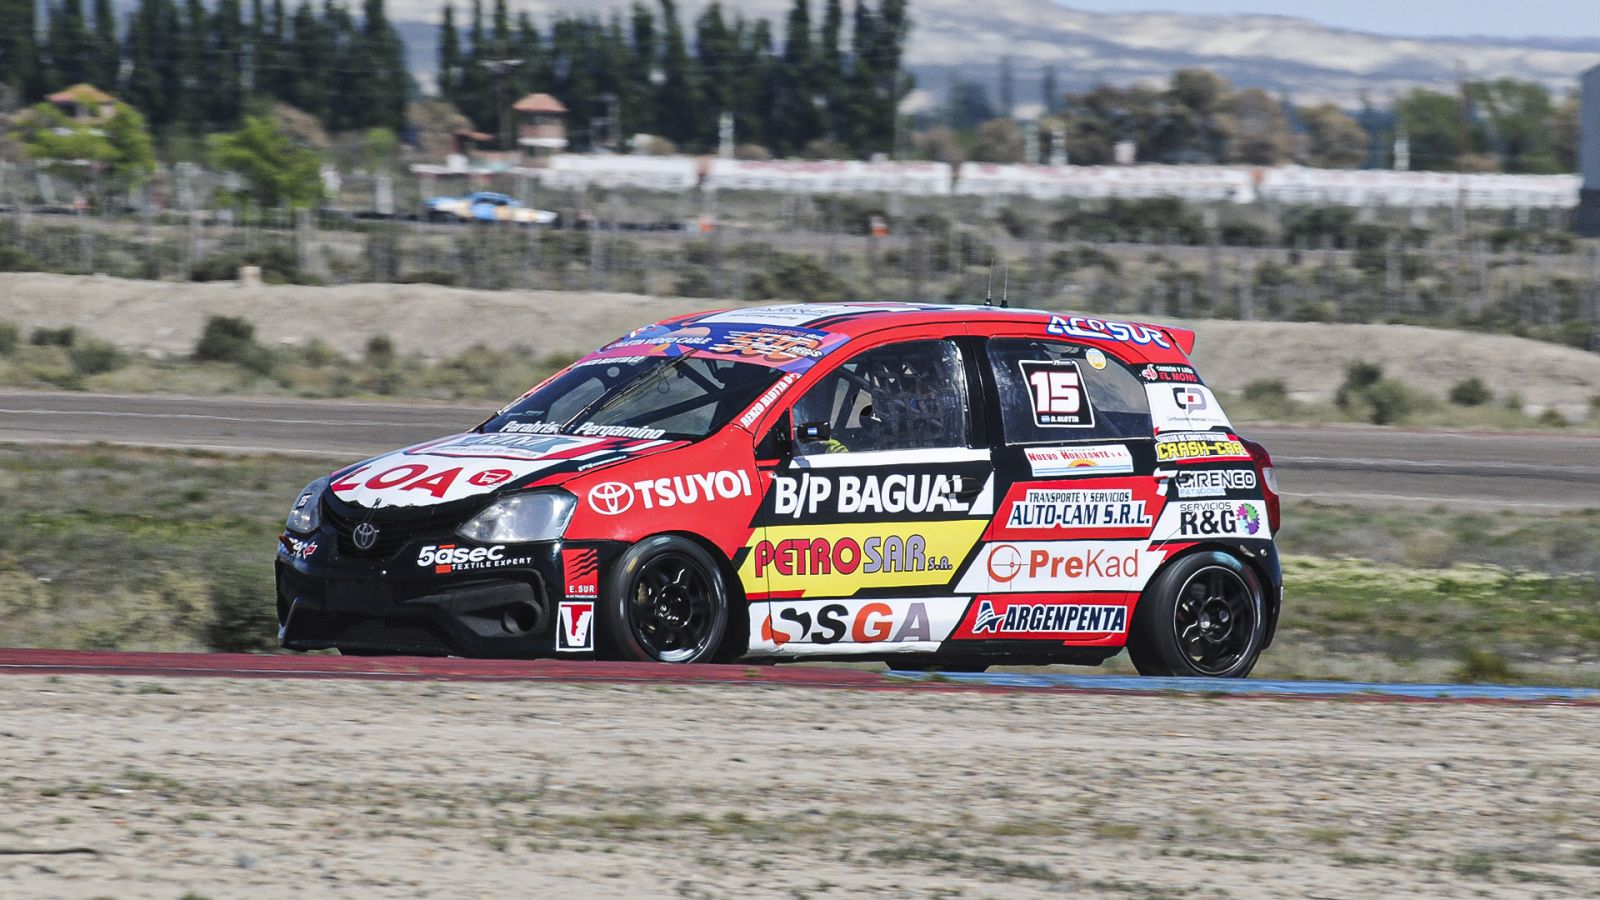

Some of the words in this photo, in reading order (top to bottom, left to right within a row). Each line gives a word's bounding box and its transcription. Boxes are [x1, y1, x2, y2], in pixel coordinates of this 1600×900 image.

[1159, 372, 1171, 381] EL
[1171, 373, 1198, 382] MONO
[740, 402, 765, 428] RENZO
[760, 381, 788, 407] BLOTTA
[1030, 371, 1080, 413] 15
[573, 422, 665, 439] Pergamino
[1028, 453, 1059, 462] NUEVO
[1060, 451, 1110, 460] HORIZONTE
[634, 469, 752, 509] TSUYOI
[775, 473, 831, 518] B/P
[837, 474, 969, 514] BAGUAL
[1029, 492, 1080, 503] TRANSPORTE
[1082, 492, 1088, 502] Y
[1090, 491, 1130, 502] SERVICIOS
[1010, 504, 1098, 526] AUTO-CAM
[1103, 503, 1150, 525] S.R.L.
[1180, 502, 1232, 511] SERVICIOS
[1180, 510, 1237, 535] R&G
[452, 561, 492, 570] TEXTILE
[494, 557, 532, 567] EXPERT
[754, 534, 926, 578] PETROSAR
[1029, 549, 1139, 578] PreKad
[1003, 606, 1126, 631] ARGENPENTA
